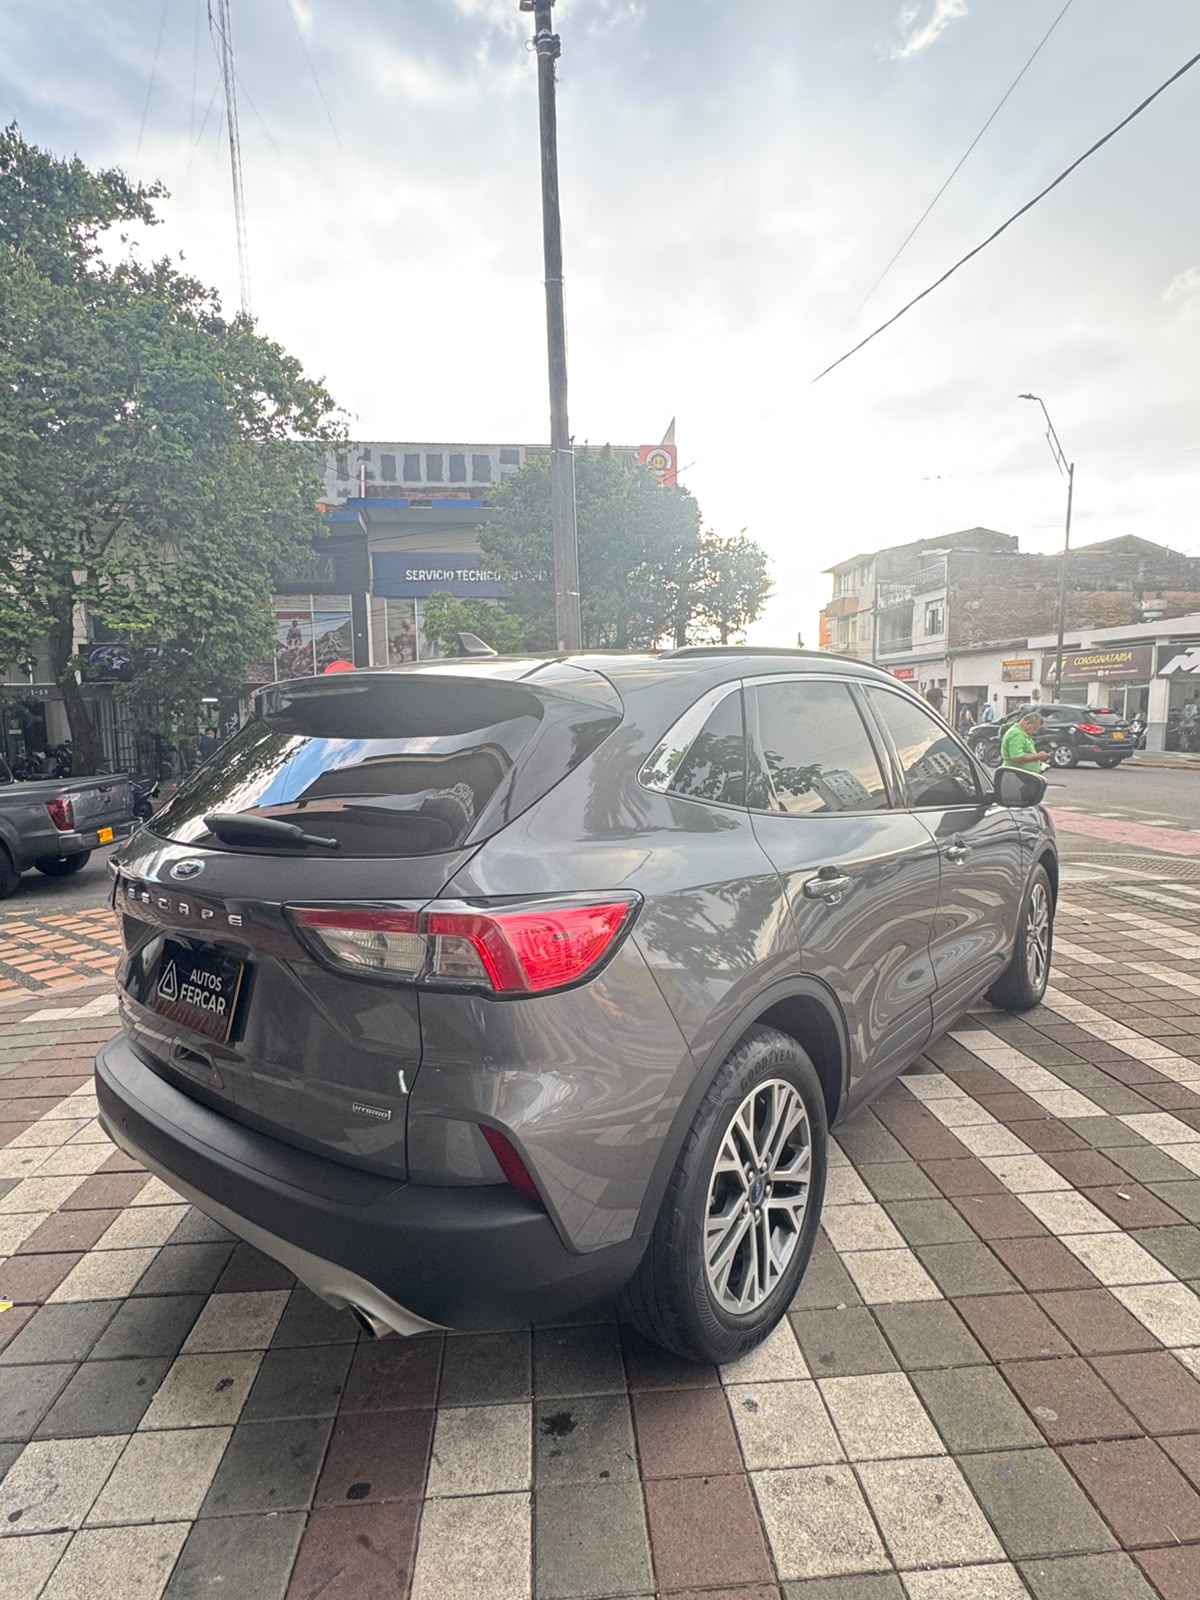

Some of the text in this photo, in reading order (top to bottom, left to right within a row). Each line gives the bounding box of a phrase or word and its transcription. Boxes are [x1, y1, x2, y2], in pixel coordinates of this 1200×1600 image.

[405, 569, 454, 582] SERVICIO
[456, 567, 501, 582] TÉCNICO
[1073, 651, 1133, 667] CONSIGNATARIA
[127, 887, 243, 927] ESCAPE
[189, 968, 222, 992] AUTOS
[179, 983, 226, 1016] FERCAR
[354, 1104, 389, 1119] HYBRID
